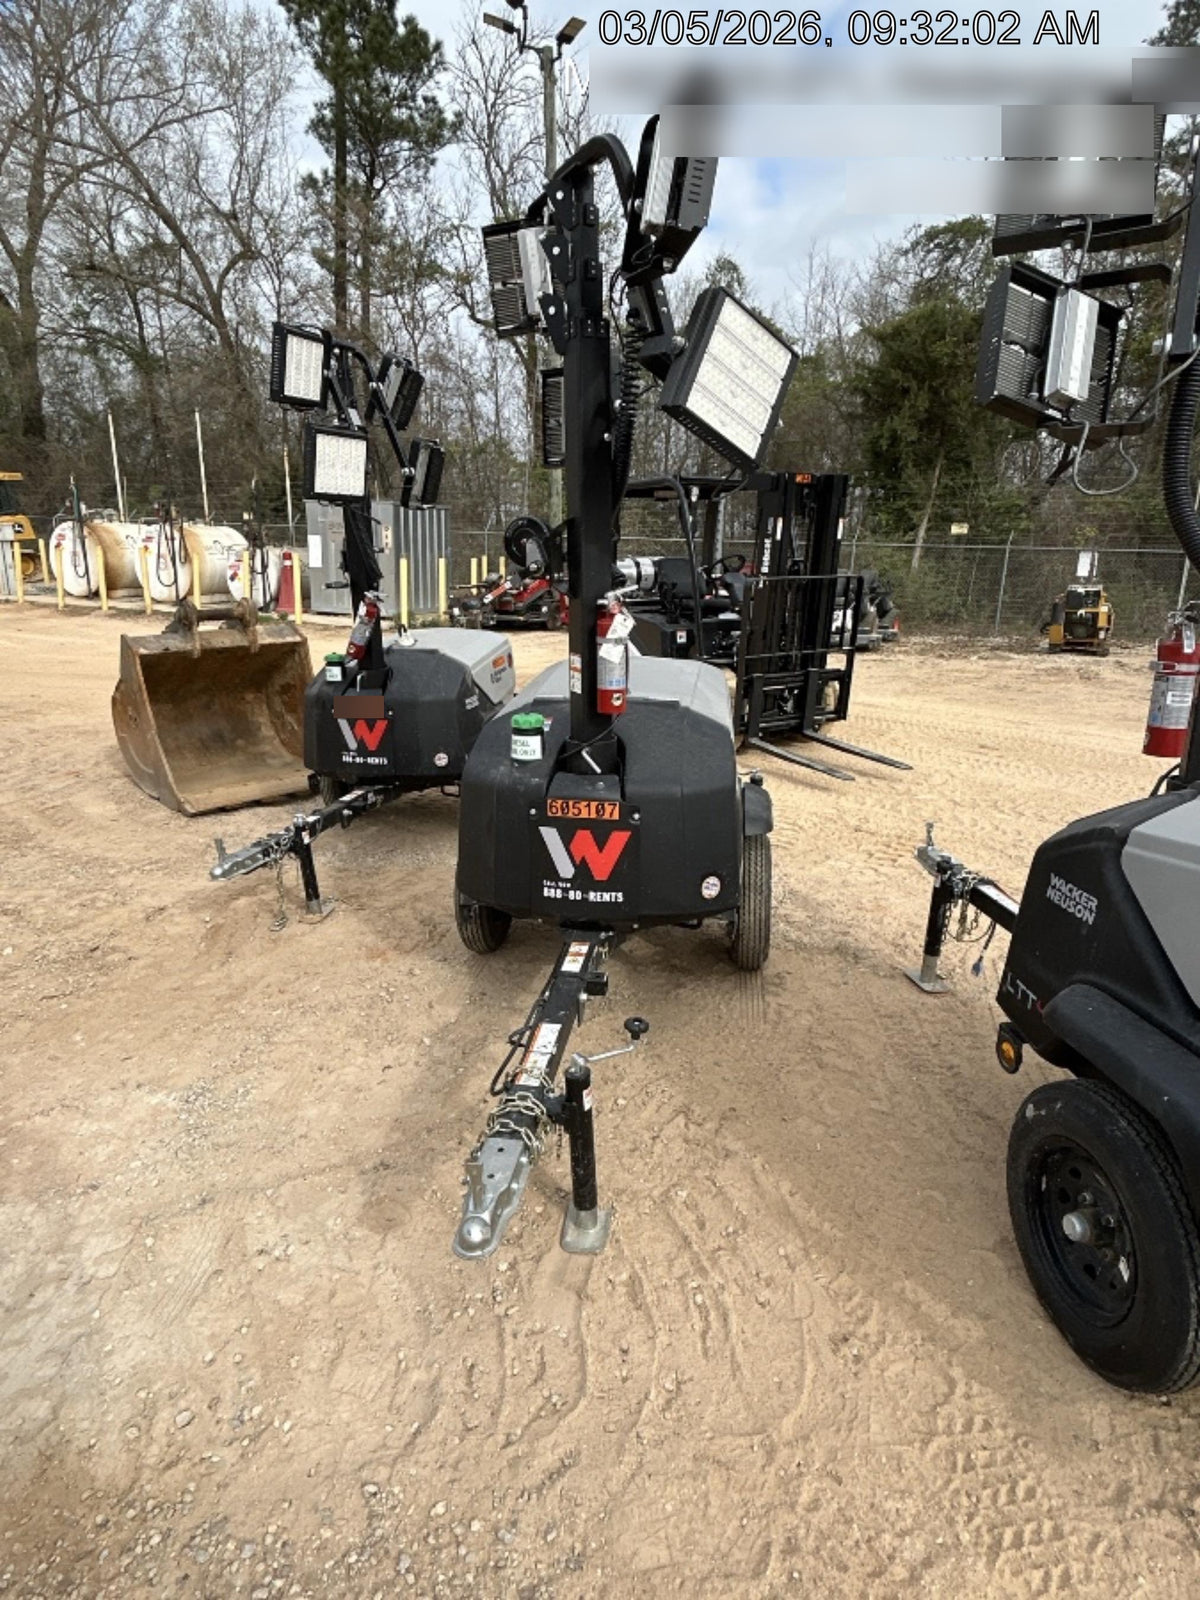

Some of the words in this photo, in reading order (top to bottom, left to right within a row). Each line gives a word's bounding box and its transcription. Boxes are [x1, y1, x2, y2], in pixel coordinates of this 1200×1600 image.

[548, 800, 618, 819] 605107
[1046, 885, 1096, 926] NEUSON
[1050, 872, 1098, 913] WACKER
[1006, 971, 1044, 1013] LTT
